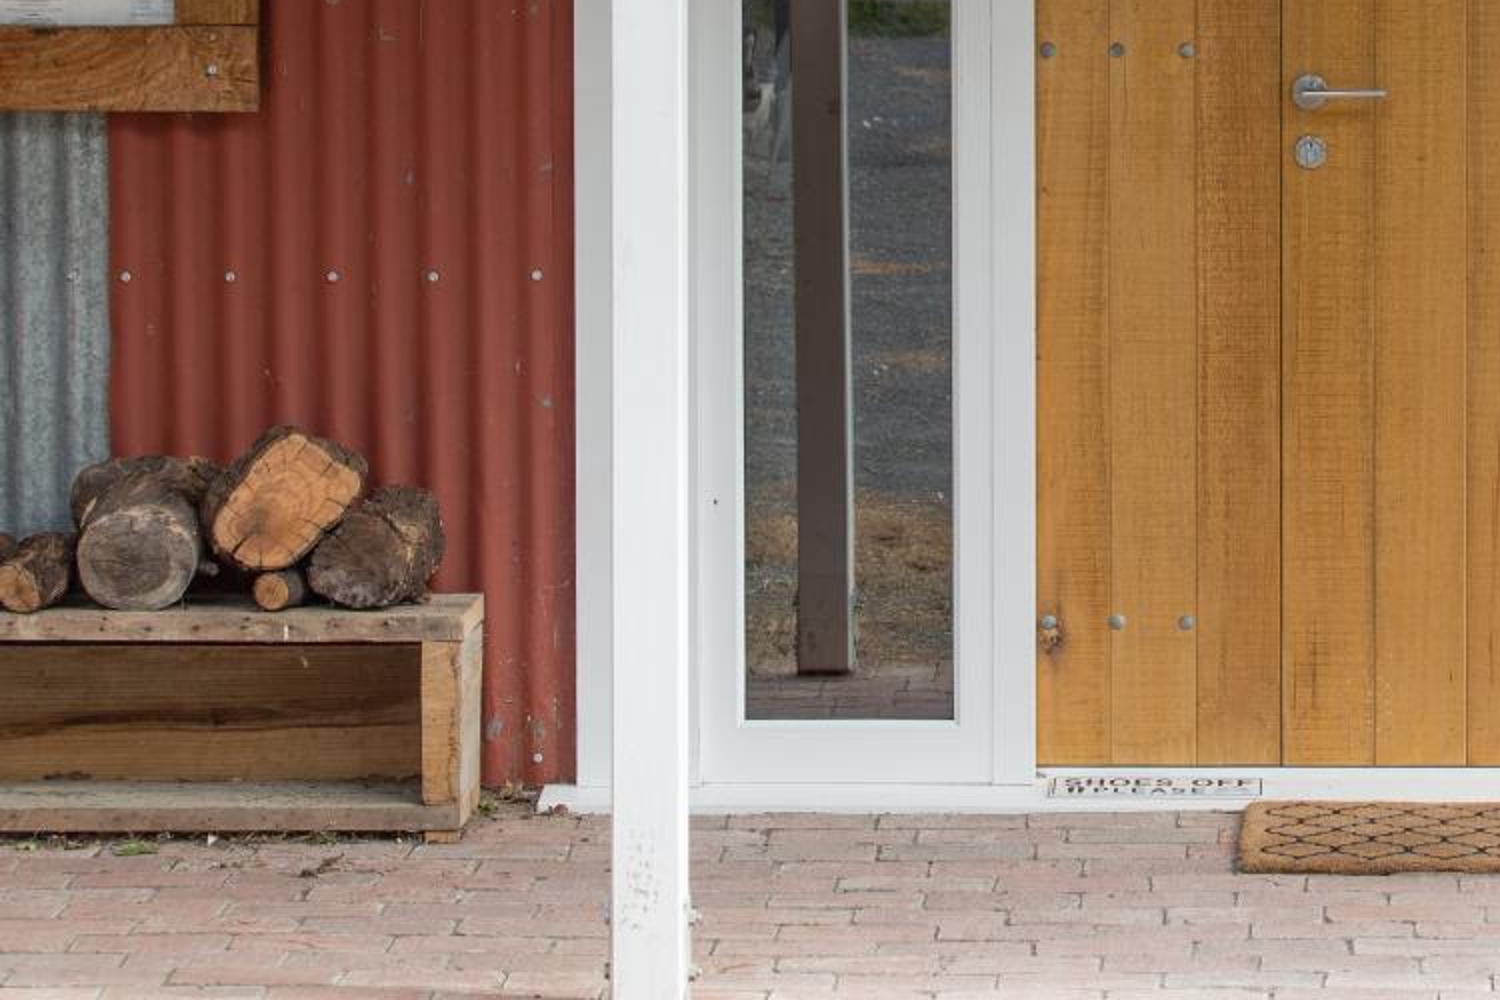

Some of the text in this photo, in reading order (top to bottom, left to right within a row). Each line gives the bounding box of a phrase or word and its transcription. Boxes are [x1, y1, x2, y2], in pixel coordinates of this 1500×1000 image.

[1065, 777, 1253, 787] SHOES OFF
[1093, 787, 1205, 795] PLEASE
